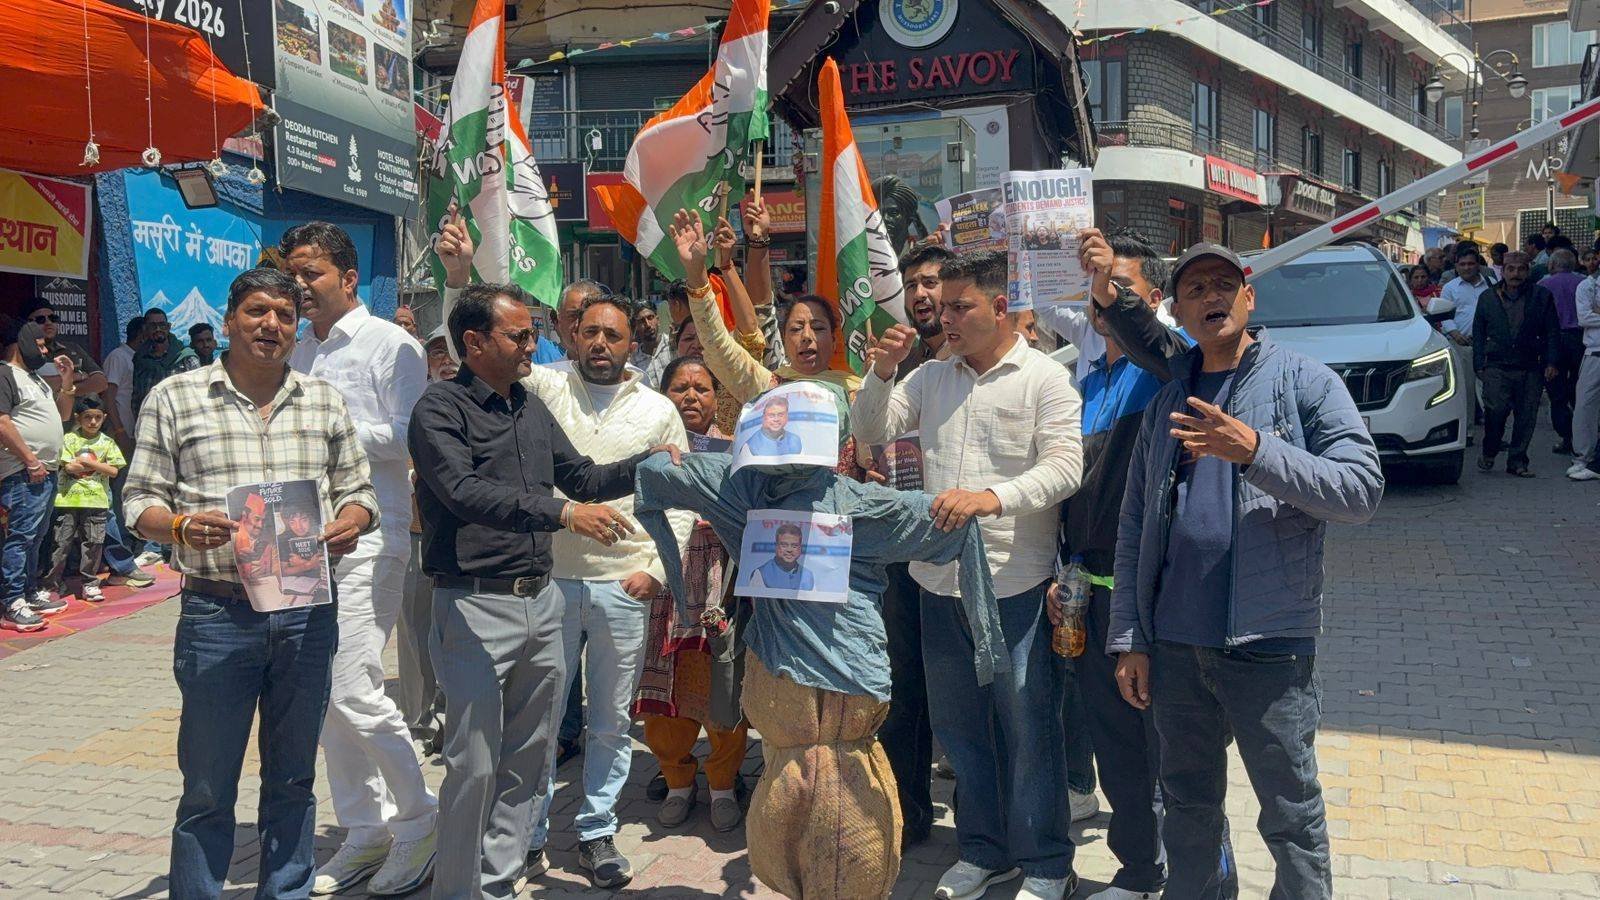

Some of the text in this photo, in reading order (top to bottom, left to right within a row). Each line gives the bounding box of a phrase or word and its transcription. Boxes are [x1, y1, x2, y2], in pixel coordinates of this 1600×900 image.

[907, 49, 1020, 92] SAVOY
[284, 119, 339, 145] DEODAR KITCHEN
[285, 131, 318, 150] Restaurant
[295, 146, 311, 160] Rated
[377, 149, 411, 168] HOTEL SHIVA
[301, 160, 323, 174] Reviews
[378, 161, 414, 180] CONTINENTAL
[1004, 176, 1087, 203] ENOUGH.
[132, 214, 253, 271] मसूरी में आपका
[42, 291, 87, 307] MUSSOORIE
[54, 311, 87, 323] MMER
[57, 323, 88, 336] OPPING
